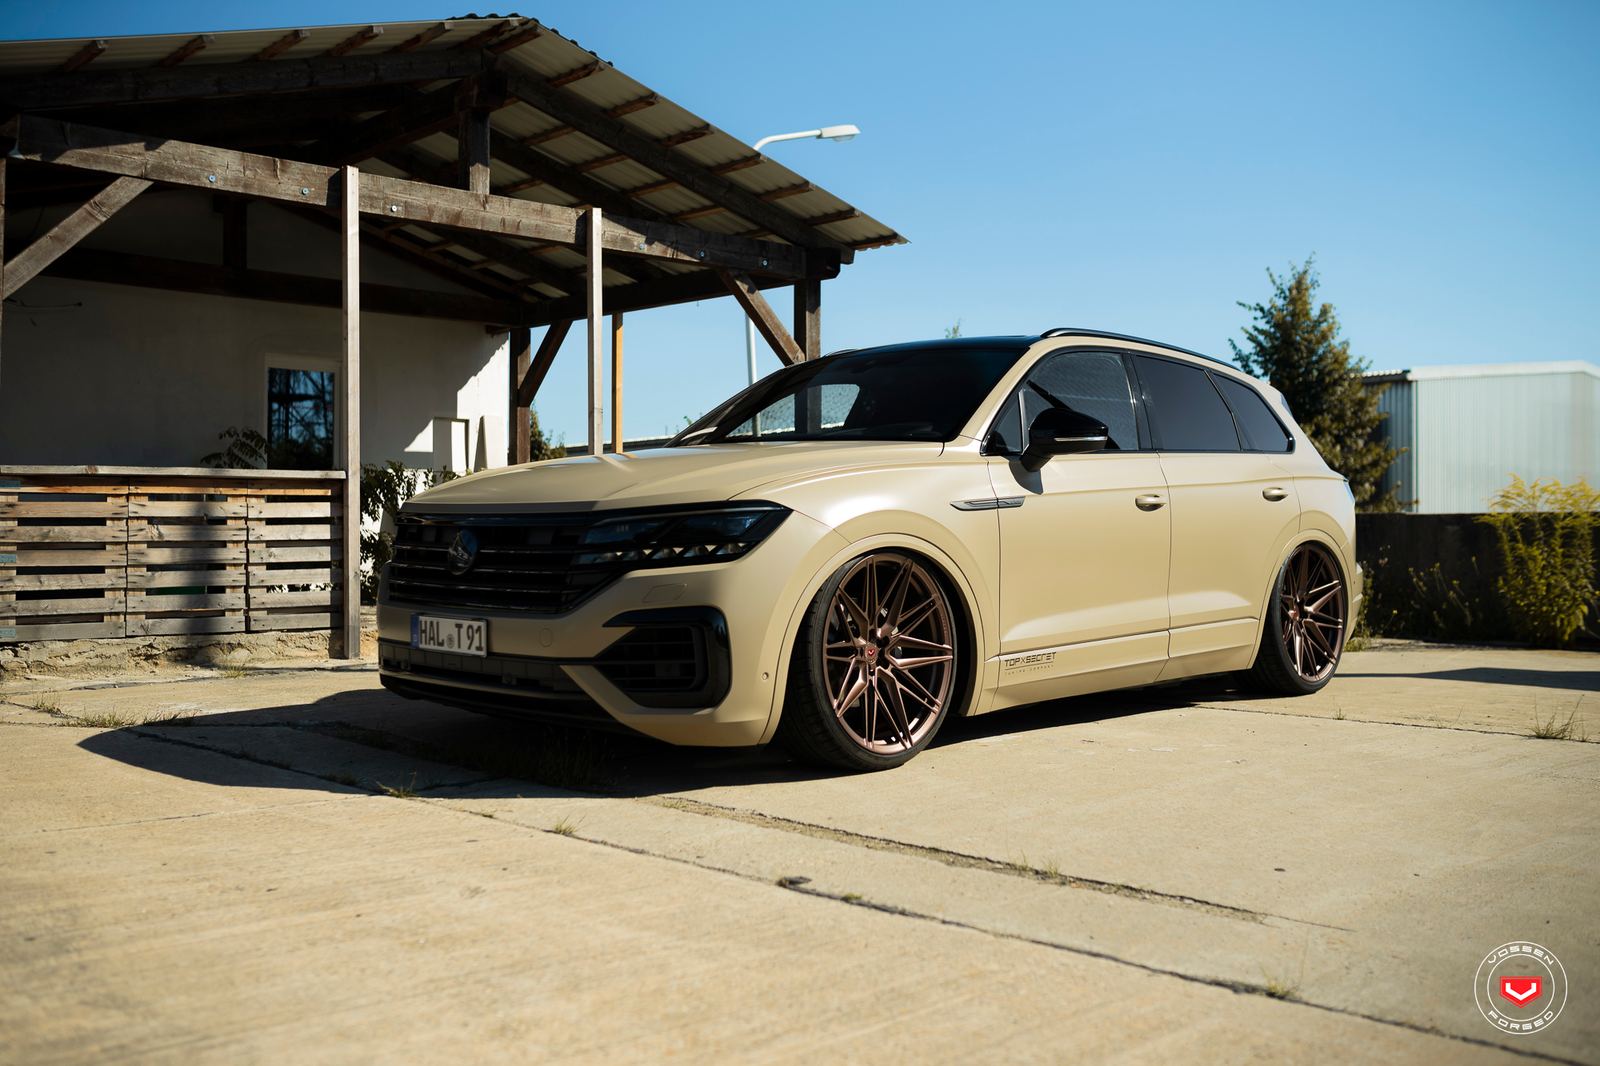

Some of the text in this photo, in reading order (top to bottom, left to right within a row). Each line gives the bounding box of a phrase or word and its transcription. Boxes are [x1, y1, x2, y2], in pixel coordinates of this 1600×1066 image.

[420, 620, 483, 651] HAL T 91
